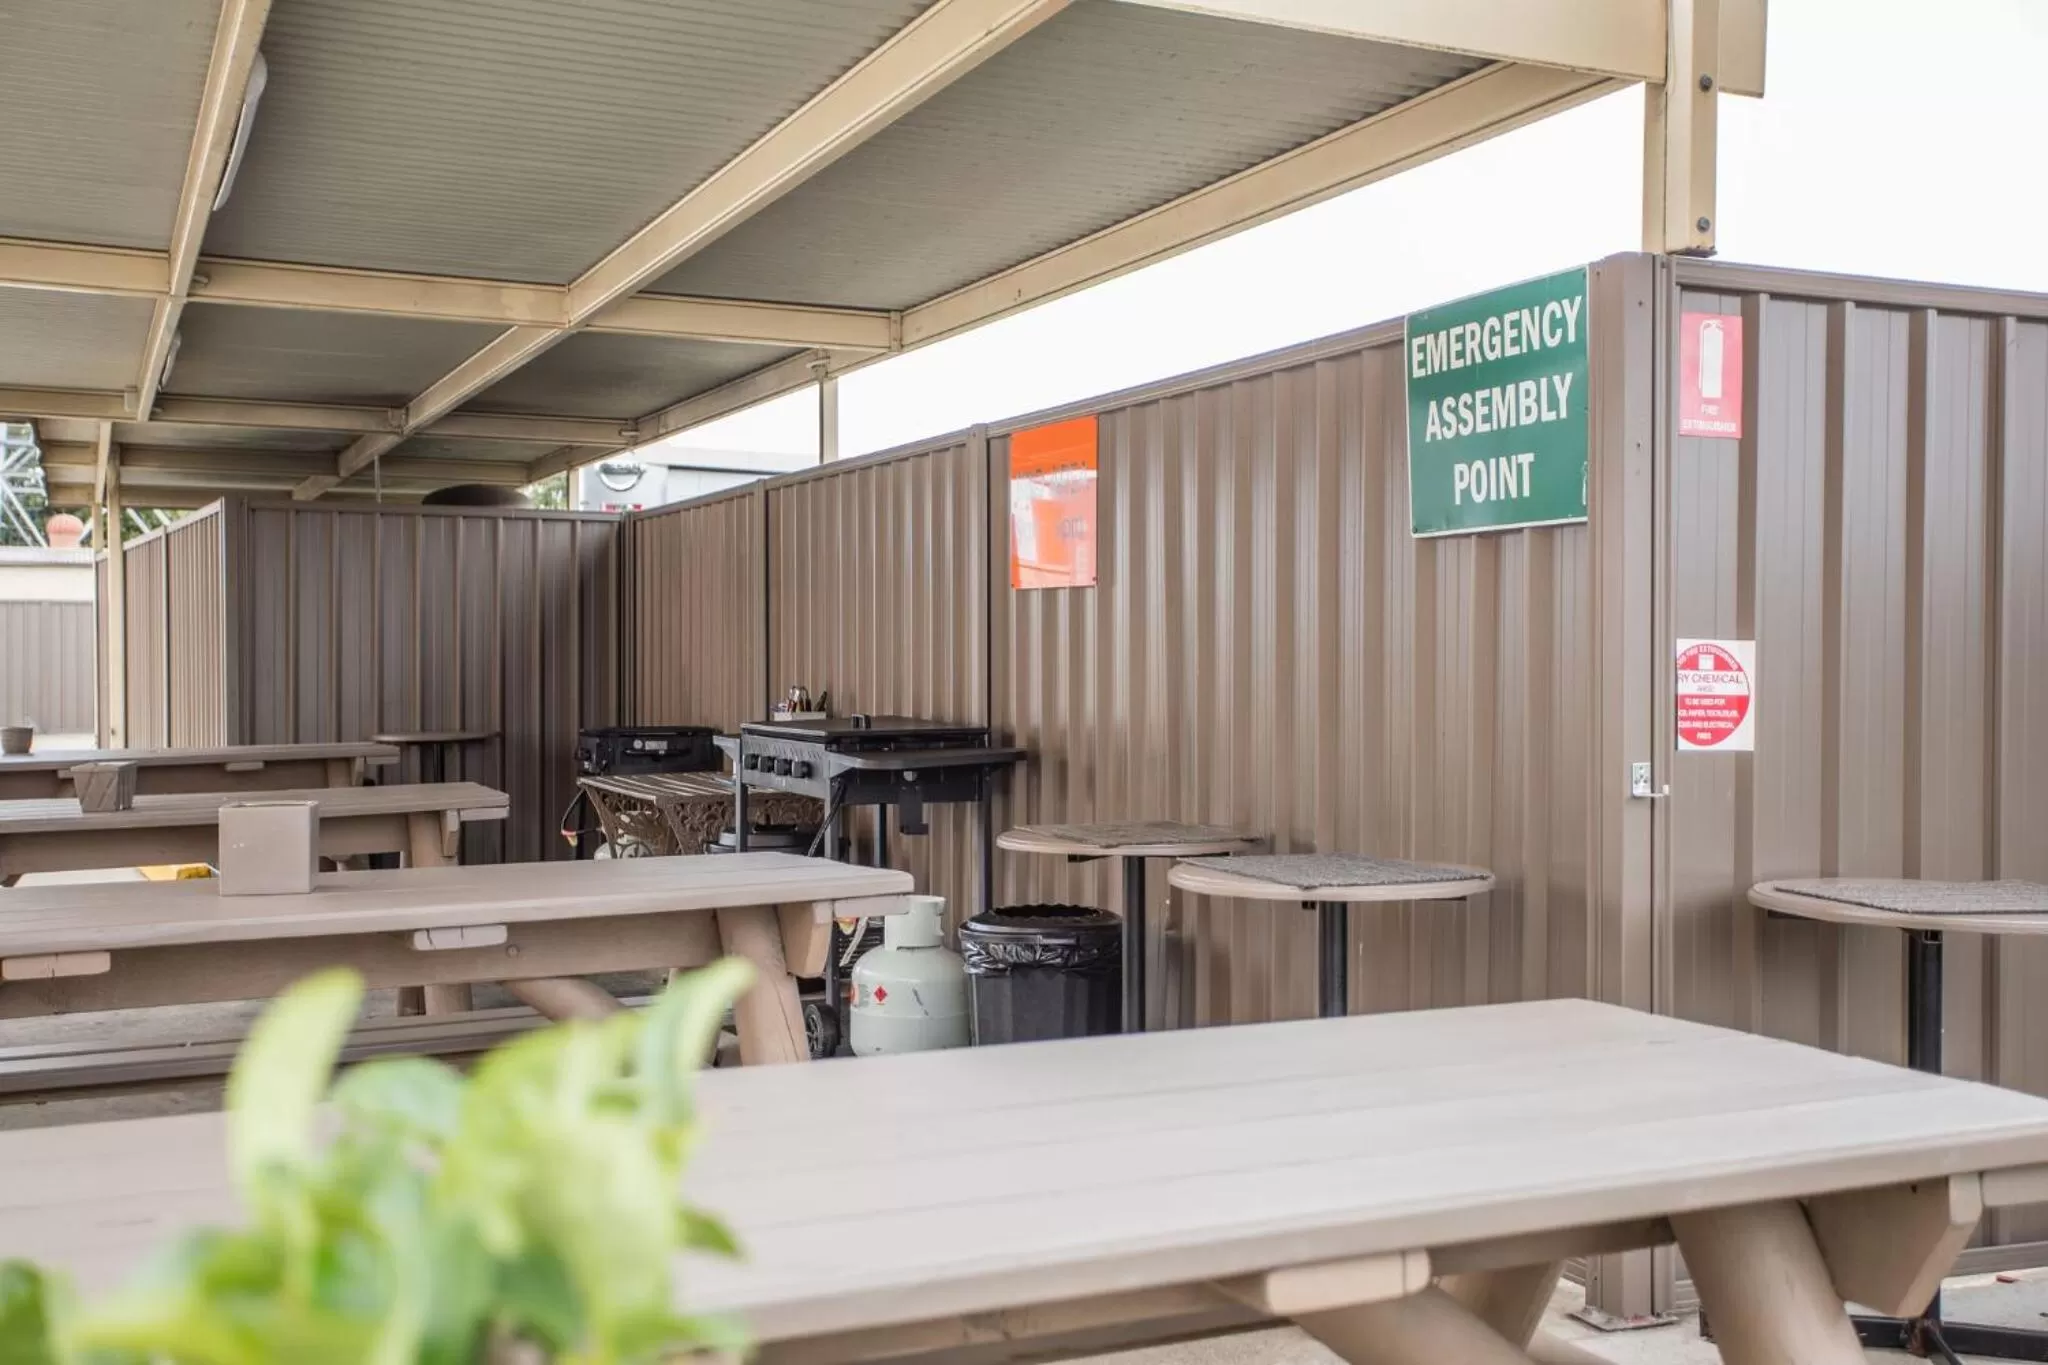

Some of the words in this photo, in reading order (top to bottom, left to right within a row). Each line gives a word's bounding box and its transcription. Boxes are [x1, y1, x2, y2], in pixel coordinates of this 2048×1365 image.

[1411, 295, 1582, 378] EMERGENCY
[1425, 372, 1573, 443] ASSEMBLY
[1453, 452, 1535, 505] POINT
[1691, 673, 1743, 684] CHEMICAL
